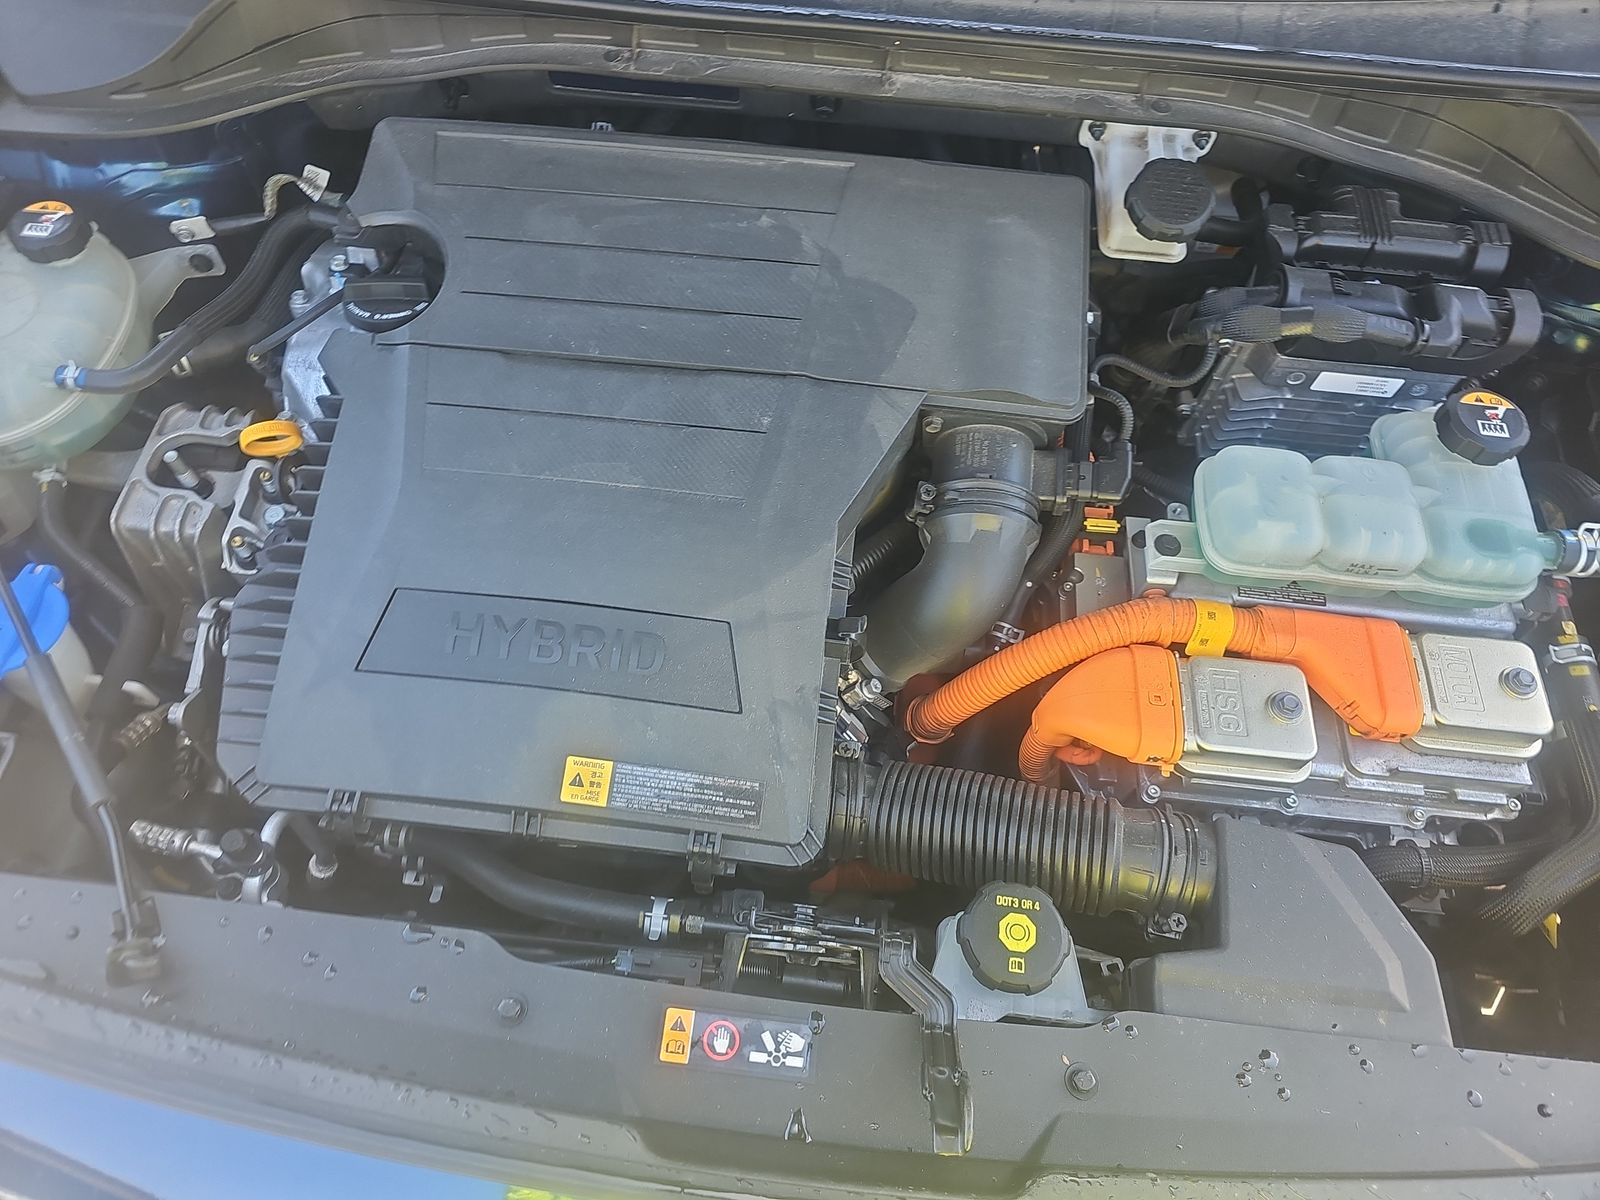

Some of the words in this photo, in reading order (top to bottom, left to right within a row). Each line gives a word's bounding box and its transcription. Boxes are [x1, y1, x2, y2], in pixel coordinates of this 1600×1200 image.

[448, 610, 667, 677] HYBRID
[1212, 674, 1242, 732] HSG
[1443, 648, 1477, 705] MOTOR
[586, 789, 601, 797] MISE
[996, 895, 1019, 909] DOT3
[1021, 899, 1033, 910] OR
[1034, 901, 1041, 911] 4
